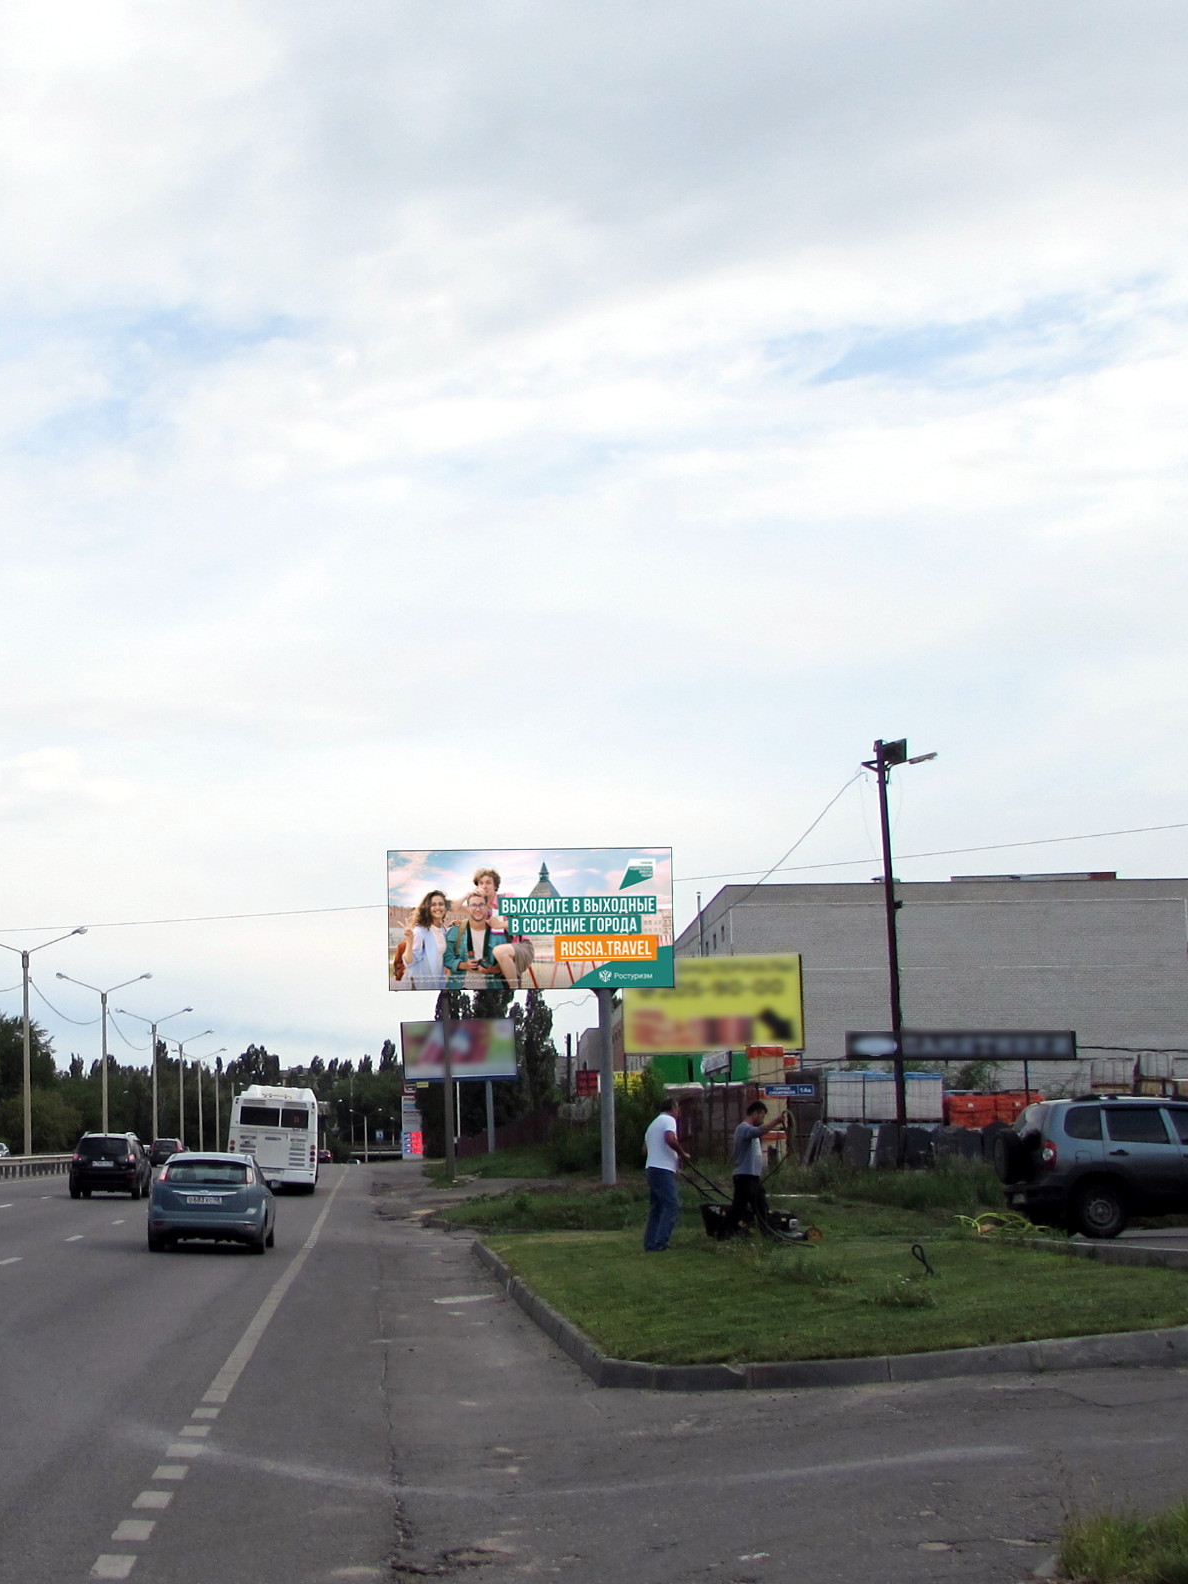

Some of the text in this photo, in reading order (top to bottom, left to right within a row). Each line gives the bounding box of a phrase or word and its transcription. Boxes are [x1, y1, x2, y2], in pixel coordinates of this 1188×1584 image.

[501, 897, 655, 915] ВЫХОДИТЕ В ВЫХОДНЫЕ
[511, 917, 638, 934] В СОСЕДНИЕ ГОРОДА
[560, 940, 652, 956] RUSSIA.TRAVEL
[613, 969, 653, 980] Ростуризм
